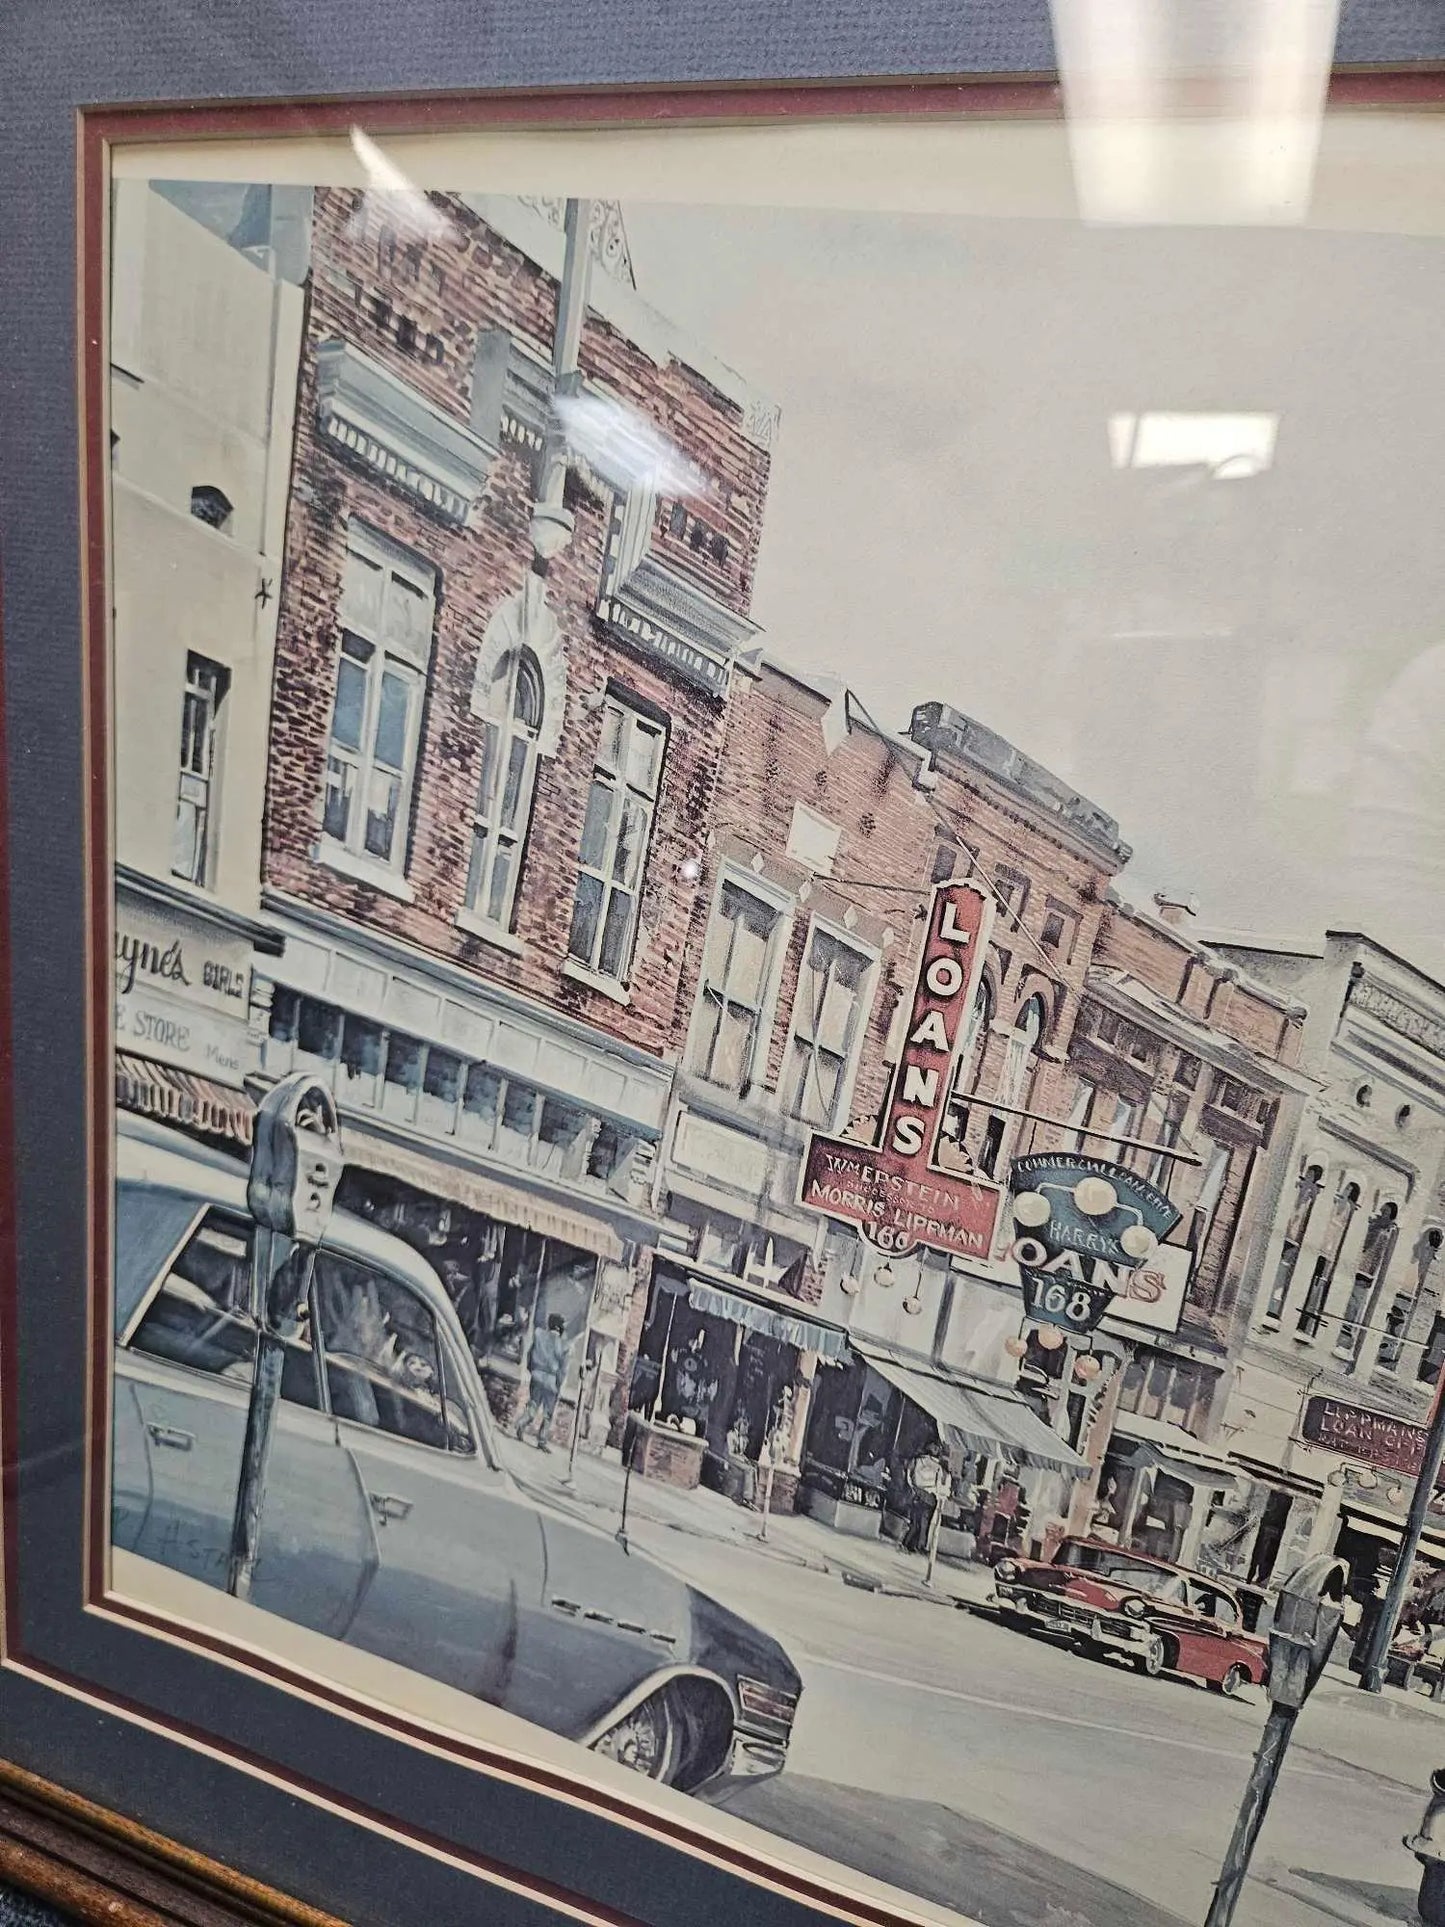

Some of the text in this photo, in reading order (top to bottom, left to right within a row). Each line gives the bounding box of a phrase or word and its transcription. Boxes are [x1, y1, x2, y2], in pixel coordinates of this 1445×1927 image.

[203, 960, 245, 998] GIRLS
[133, 1010, 191, 1052] STORE
[891, 901, 971, 1156] LOANS
[811, 1179, 984, 1249] MORRIS LIPPMAN
[867, 1221, 910, 1249] 166
[1031, 1276, 1091, 1322] 168
[1320, 1417, 1372, 1441] LOAN
